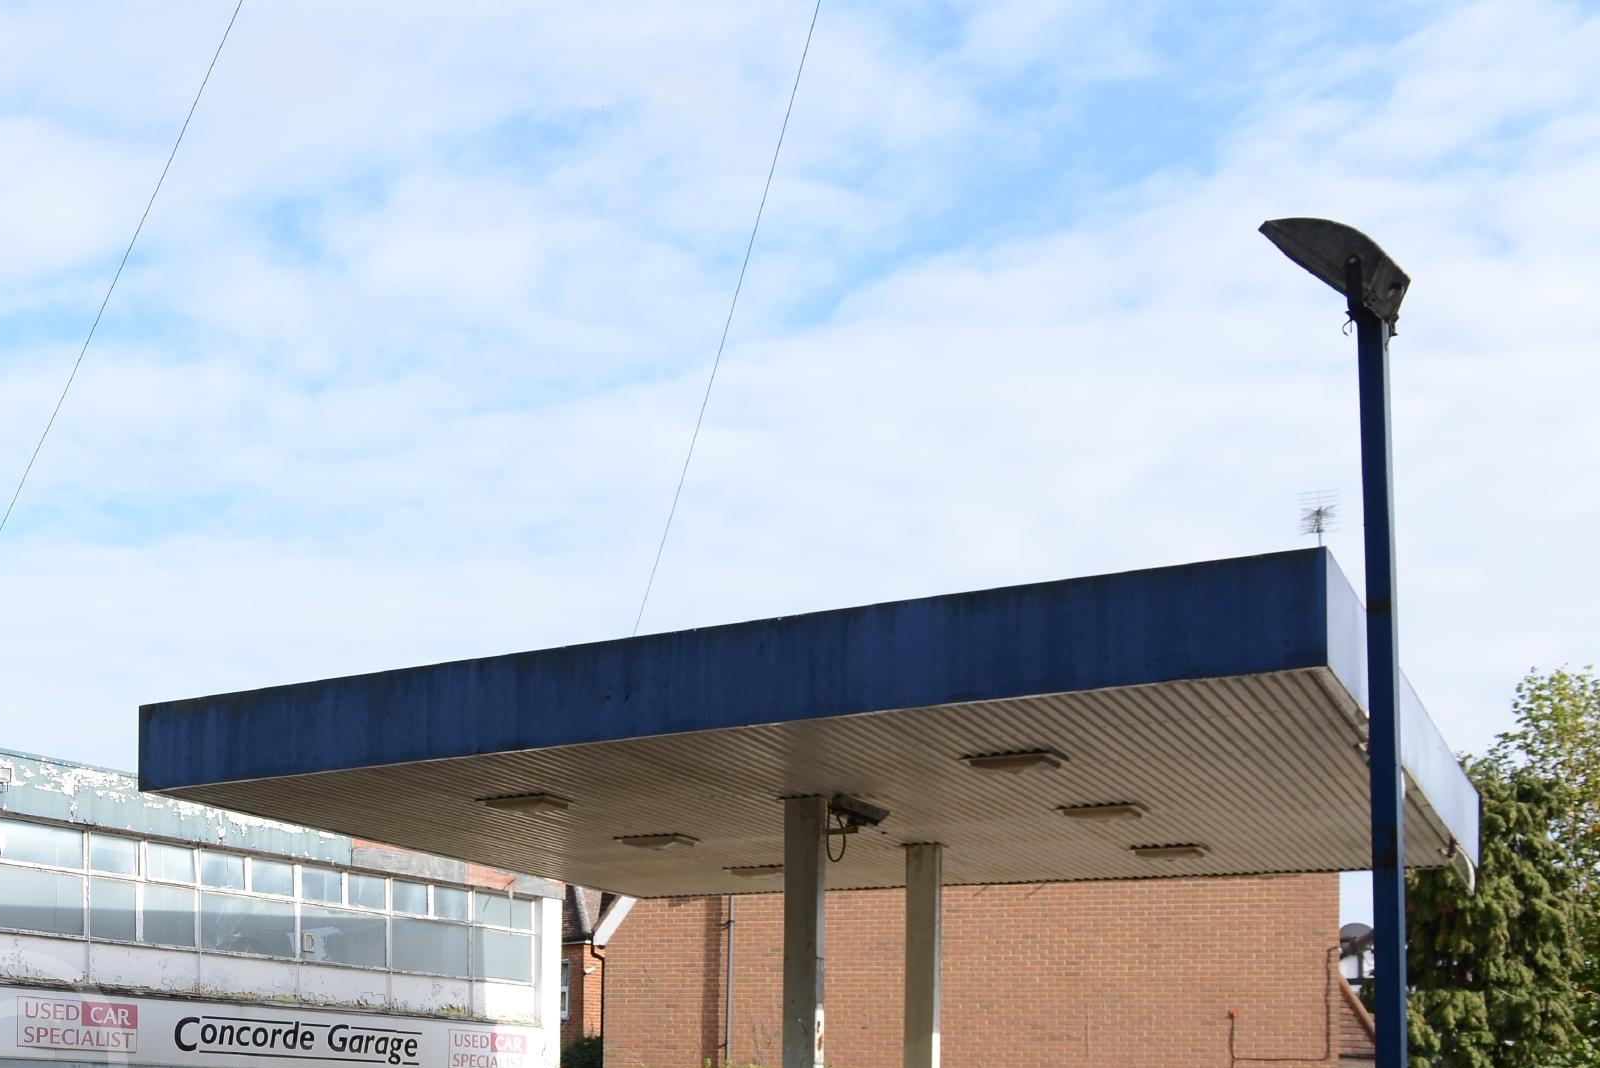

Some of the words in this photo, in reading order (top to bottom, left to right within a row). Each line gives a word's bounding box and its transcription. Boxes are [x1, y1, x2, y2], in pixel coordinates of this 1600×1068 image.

[25, 1002, 80, 1021] USED
[89, 1006, 131, 1026] CAR
[23, 1026, 135, 1049] SPECIALIST
[174, 1016, 315, 1052] Concorde
[327, 1024, 418, 1065] Garage
[454, 1033, 489, 1049] USED
[495, 1037, 523, 1051] CAR
